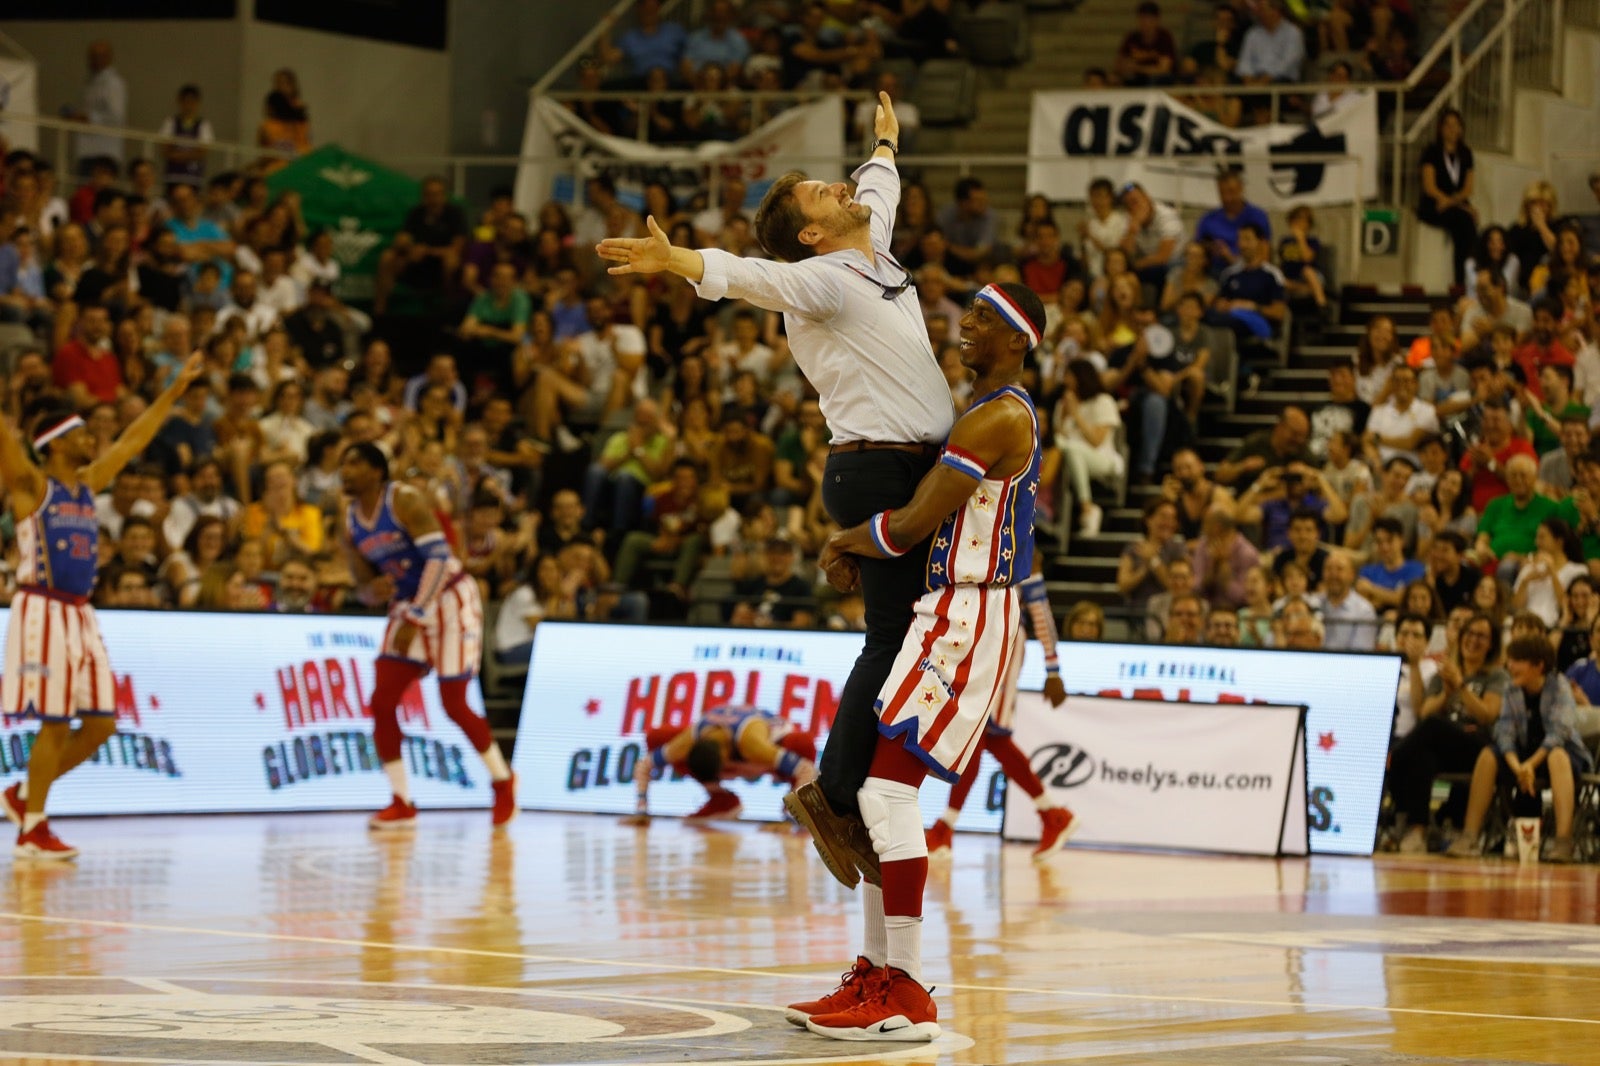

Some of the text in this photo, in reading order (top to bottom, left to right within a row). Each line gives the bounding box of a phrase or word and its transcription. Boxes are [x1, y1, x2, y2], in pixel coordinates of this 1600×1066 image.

[1365, 221, 1391, 255] D
[1119, 661, 1238, 685] THE ORIGINAL
[277, 656, 431, 730] HARLM
[1100, 758, 1273, 793] heelys.eu.com
